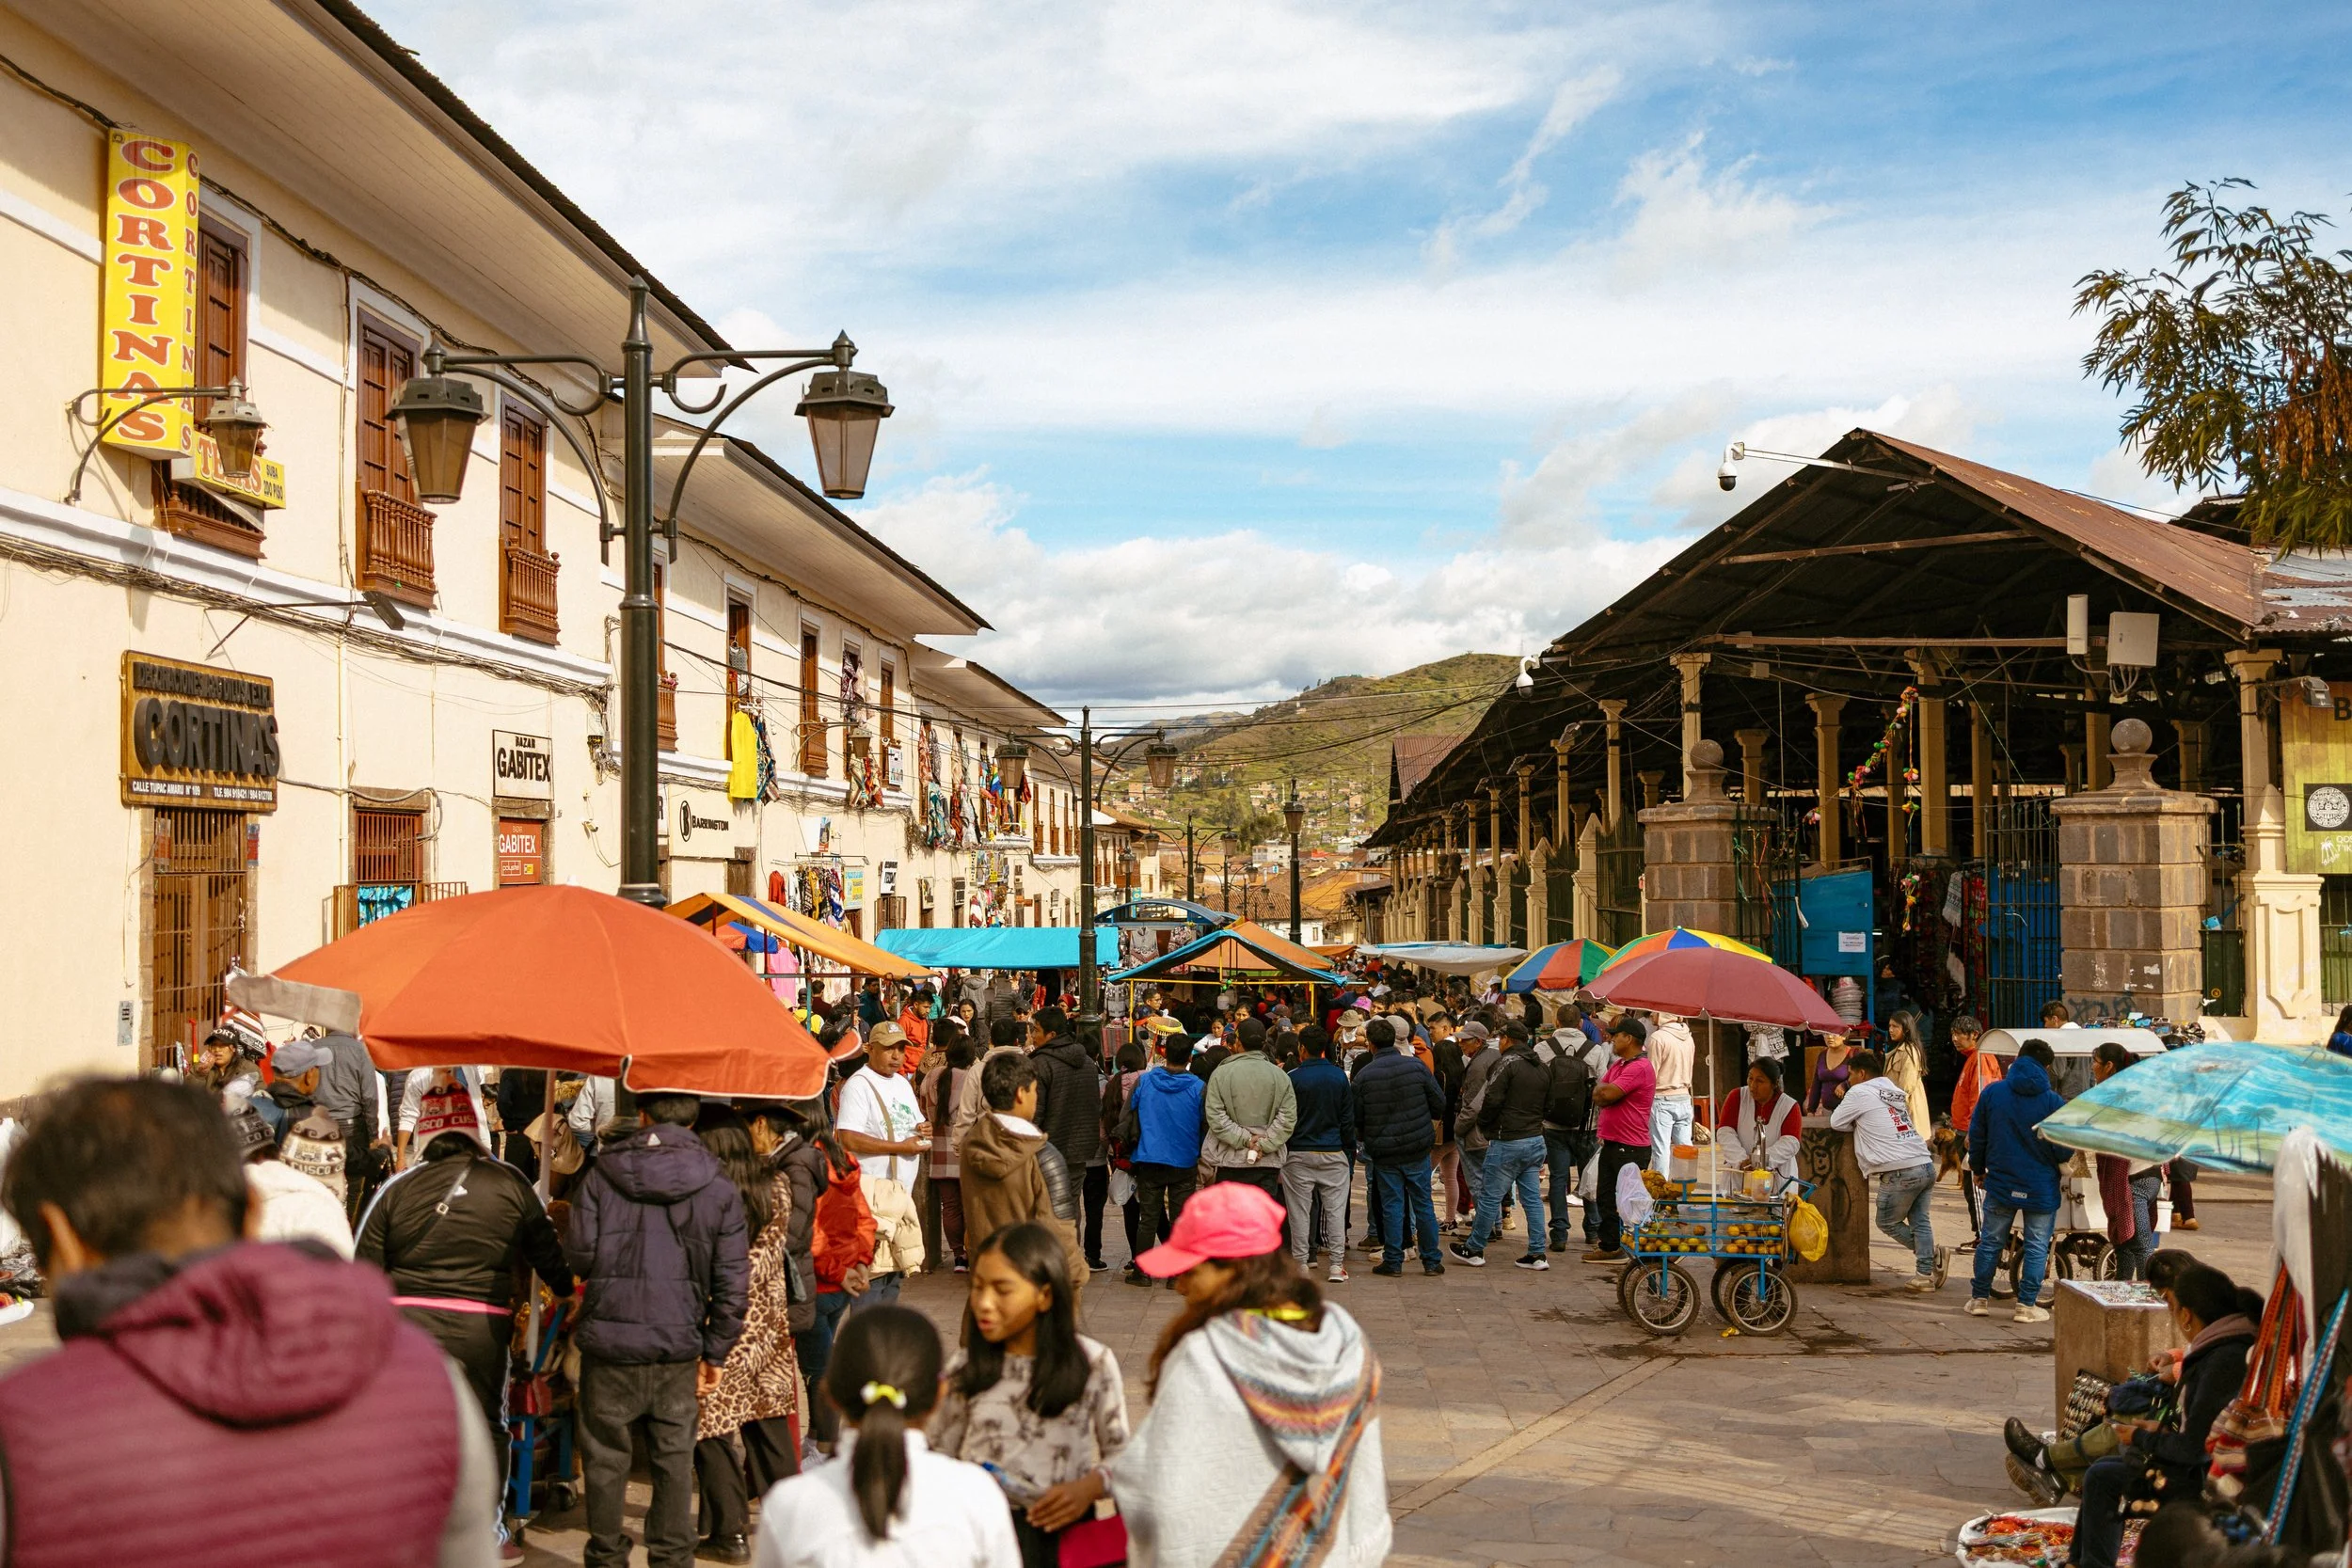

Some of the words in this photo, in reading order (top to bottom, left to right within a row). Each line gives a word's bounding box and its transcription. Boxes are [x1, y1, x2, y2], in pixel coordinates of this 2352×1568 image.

[109, 139, 176, 441] CORTINAS
[181, 152, 199, 451] CORTINAS
[198, 436, 262, 496] TES
[265, 464, 278, 478] SUBA
[263, 480, 273, 498] 2DO
[273, 484, 283, 500] PISO
[135, 662, 202, 696] DECORACIONES
[136, 698, 279, 776] CORTINAS
[516, 736, 535, 749] BAZAR
[497, 748, 550, 783] GABITEX
[133, 781, 150, 792] CALLE
[150, 782, 167, 795] TUPAC
[167, 783, 183, 796] AMARU
[500, 834, 536, 853] GABITEX
[292, 1162, 331, 1176] CUSCO
